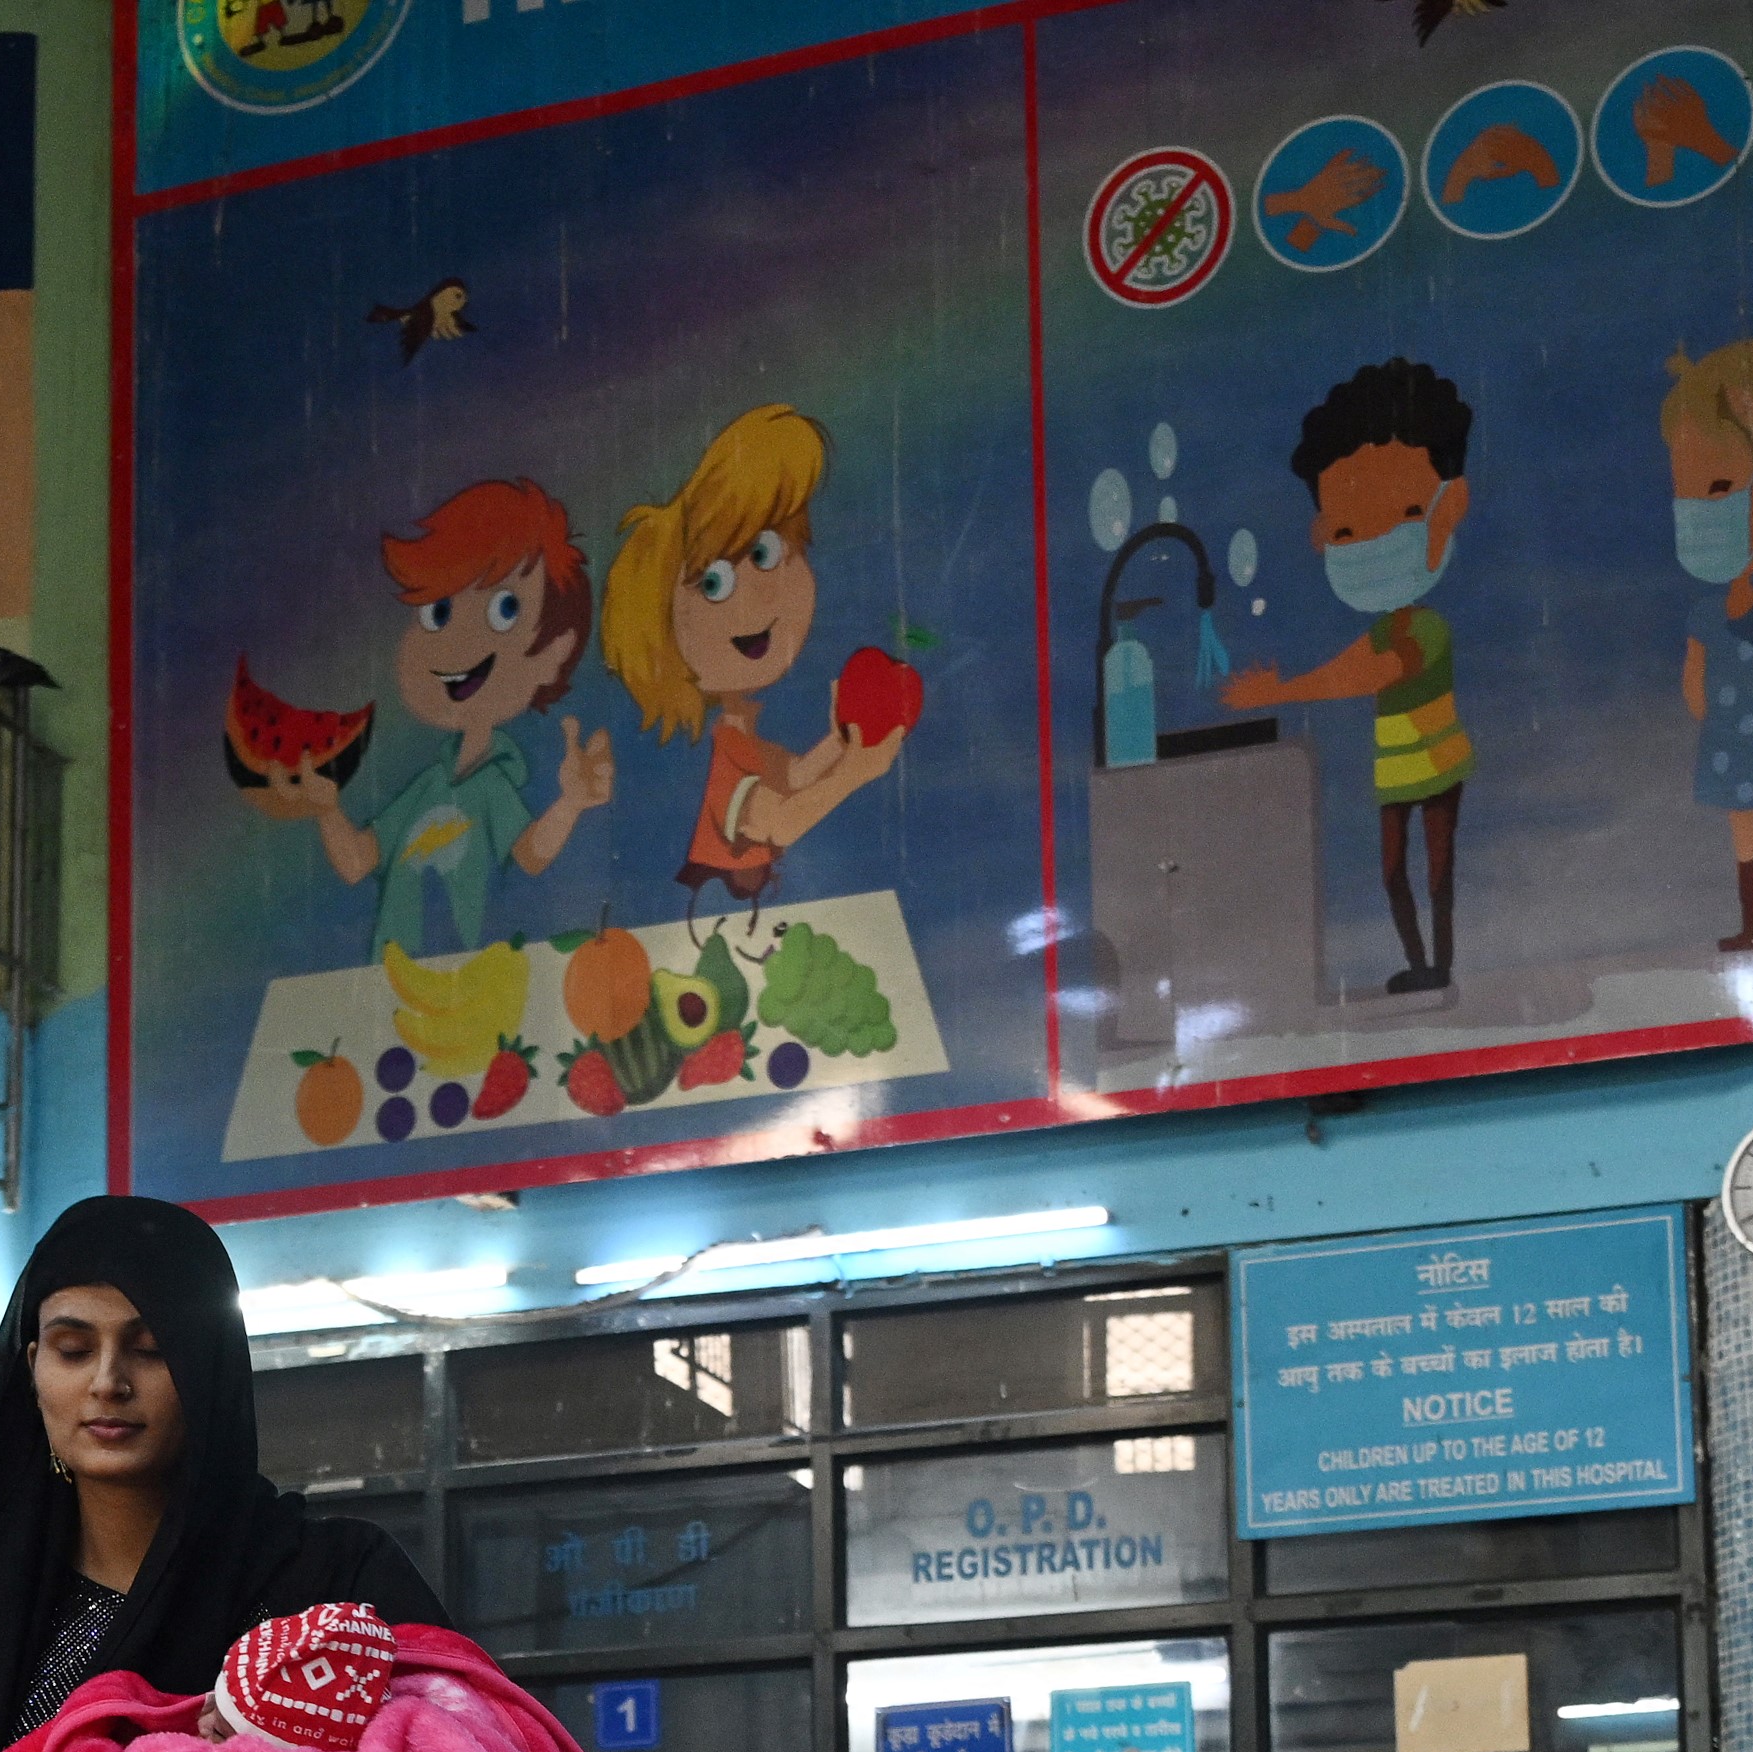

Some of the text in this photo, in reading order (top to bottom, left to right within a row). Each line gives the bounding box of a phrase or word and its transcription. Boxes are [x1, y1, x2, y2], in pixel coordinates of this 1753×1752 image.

[1416, 1254, 1490, 1287] नोटिस
[1287, 1286, 1629, 1349] इस अस्पताल में केवल 12 साल की
[1278, 1364, 1319, 1391] आयु
[1328, 1360, 1363, 1383] तक
[1371, 1352, 1392, 1377] के
[1402, 1346, 1453, 1375] बच्चों
[1463, 1351, 1491, 1369] का
[1500, 1344, 1557, 1371] इलाज
[1566, 1334, 1609, 1363] होता
[1402, 1388, 1513, 1422] NOTICE
[1318, 1427, 1605, 1472] CHILDREN UP TO THE AGE OF 12
[1262, 1458, 1667, 1513] YEARS ONLY ARE TREATED IN THIS HOSPITAL
[966, 1490, 1106, 1538] O. P. D.
[913, 1535, 1163, 1583] REGISTRATION
[617, 1697, 637, 1733] 1
